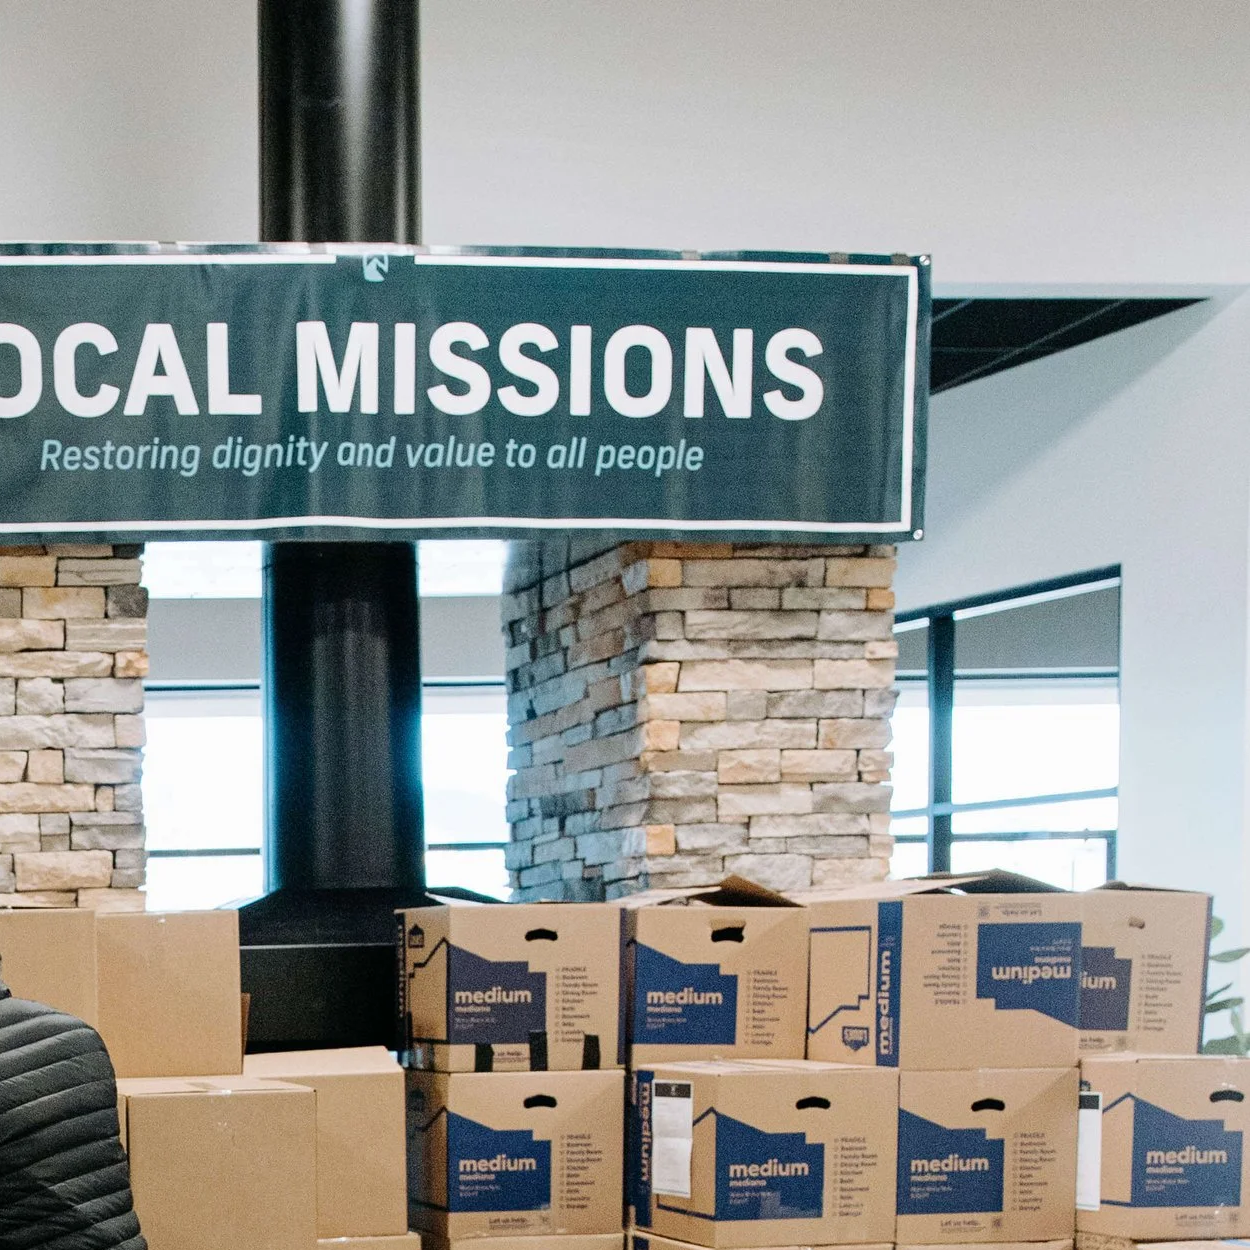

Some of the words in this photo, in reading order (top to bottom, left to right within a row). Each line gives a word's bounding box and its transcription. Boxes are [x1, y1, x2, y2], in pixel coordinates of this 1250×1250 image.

[296, 320, 825, 421] MISSIONS
[40, 436, 202, 478] Restoring
[211, 434, 329, 477] dignity
[336, 435, 396, 469] and
[405, 435, 495, 470] value
[504, 438, 536, 469] to
[546, 435, 586, 470] all
[594, 438, 704, 478] people
[991, 965, 1071, 985] medium
[1081, 971, 1117, 990] ium
[454, 986, 532, 1004] medium
[646, 987, 723, 1005] medium
[877, 949, 891, 1055] medium
[459, 1153, 537, 1172] medium
[910, 1153, 989, 1172] medium
[1146, 1145, 1227, 1165] medium
[729, 1158, 810, 1177] medium
